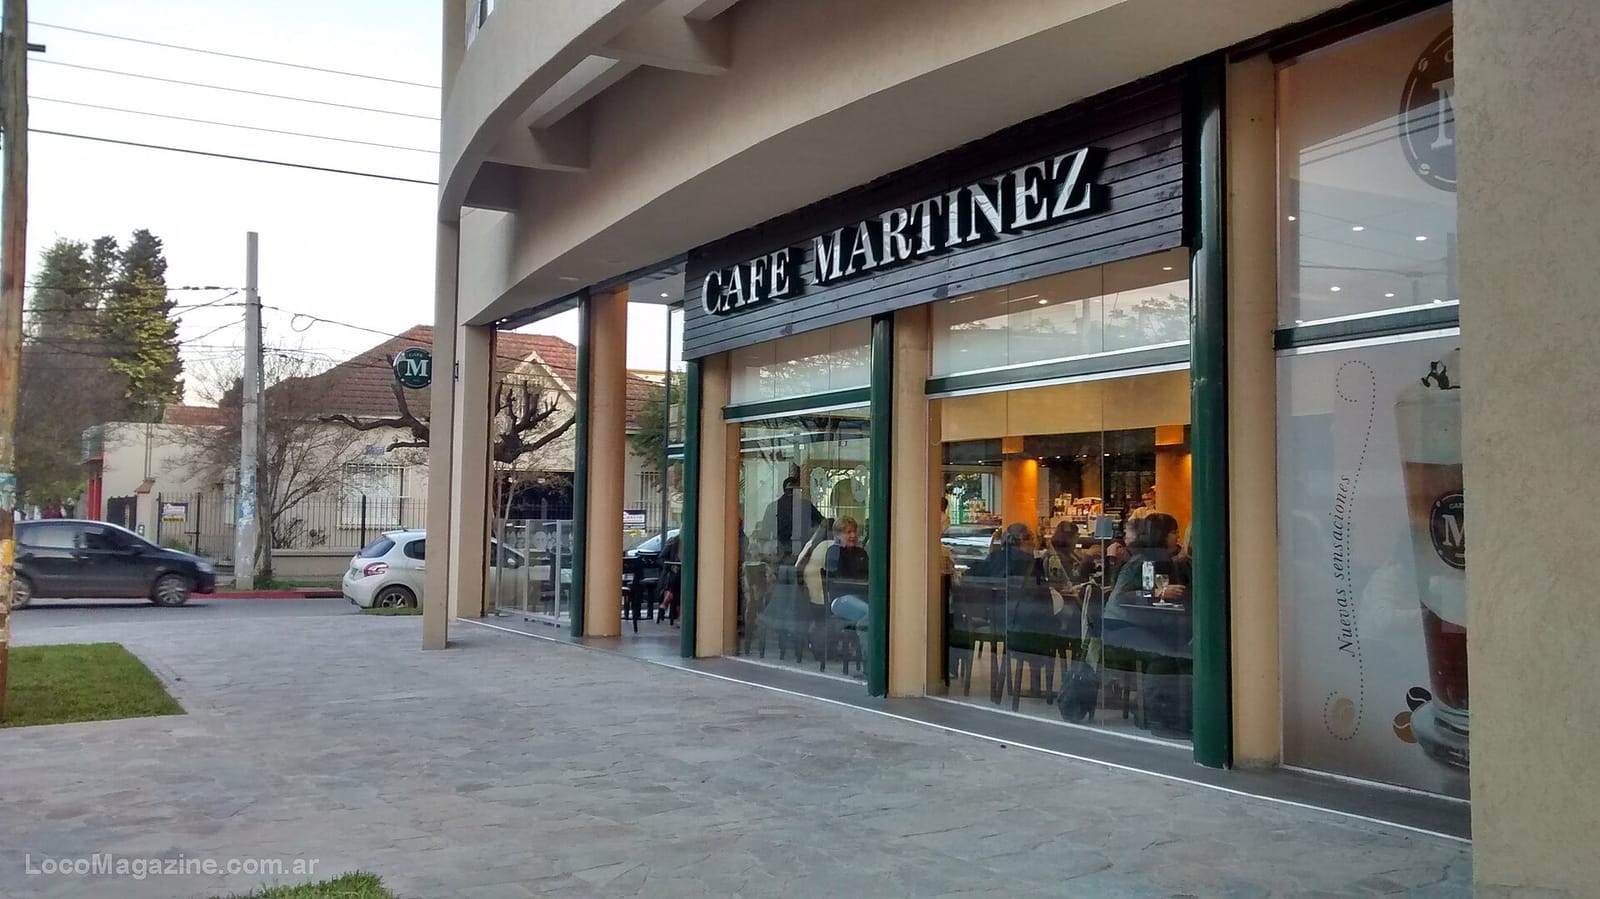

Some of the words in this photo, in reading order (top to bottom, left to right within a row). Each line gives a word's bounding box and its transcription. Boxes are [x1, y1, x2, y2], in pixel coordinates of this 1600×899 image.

[701, 246, 790, 315] CAFE
[812, 147, 1092, 285] MARTINEZ
[404, 359, 429, 377] M
[1328, 474, 1350, 581] sensaciones
[1336, 588, 1355, 657] Nuevas
